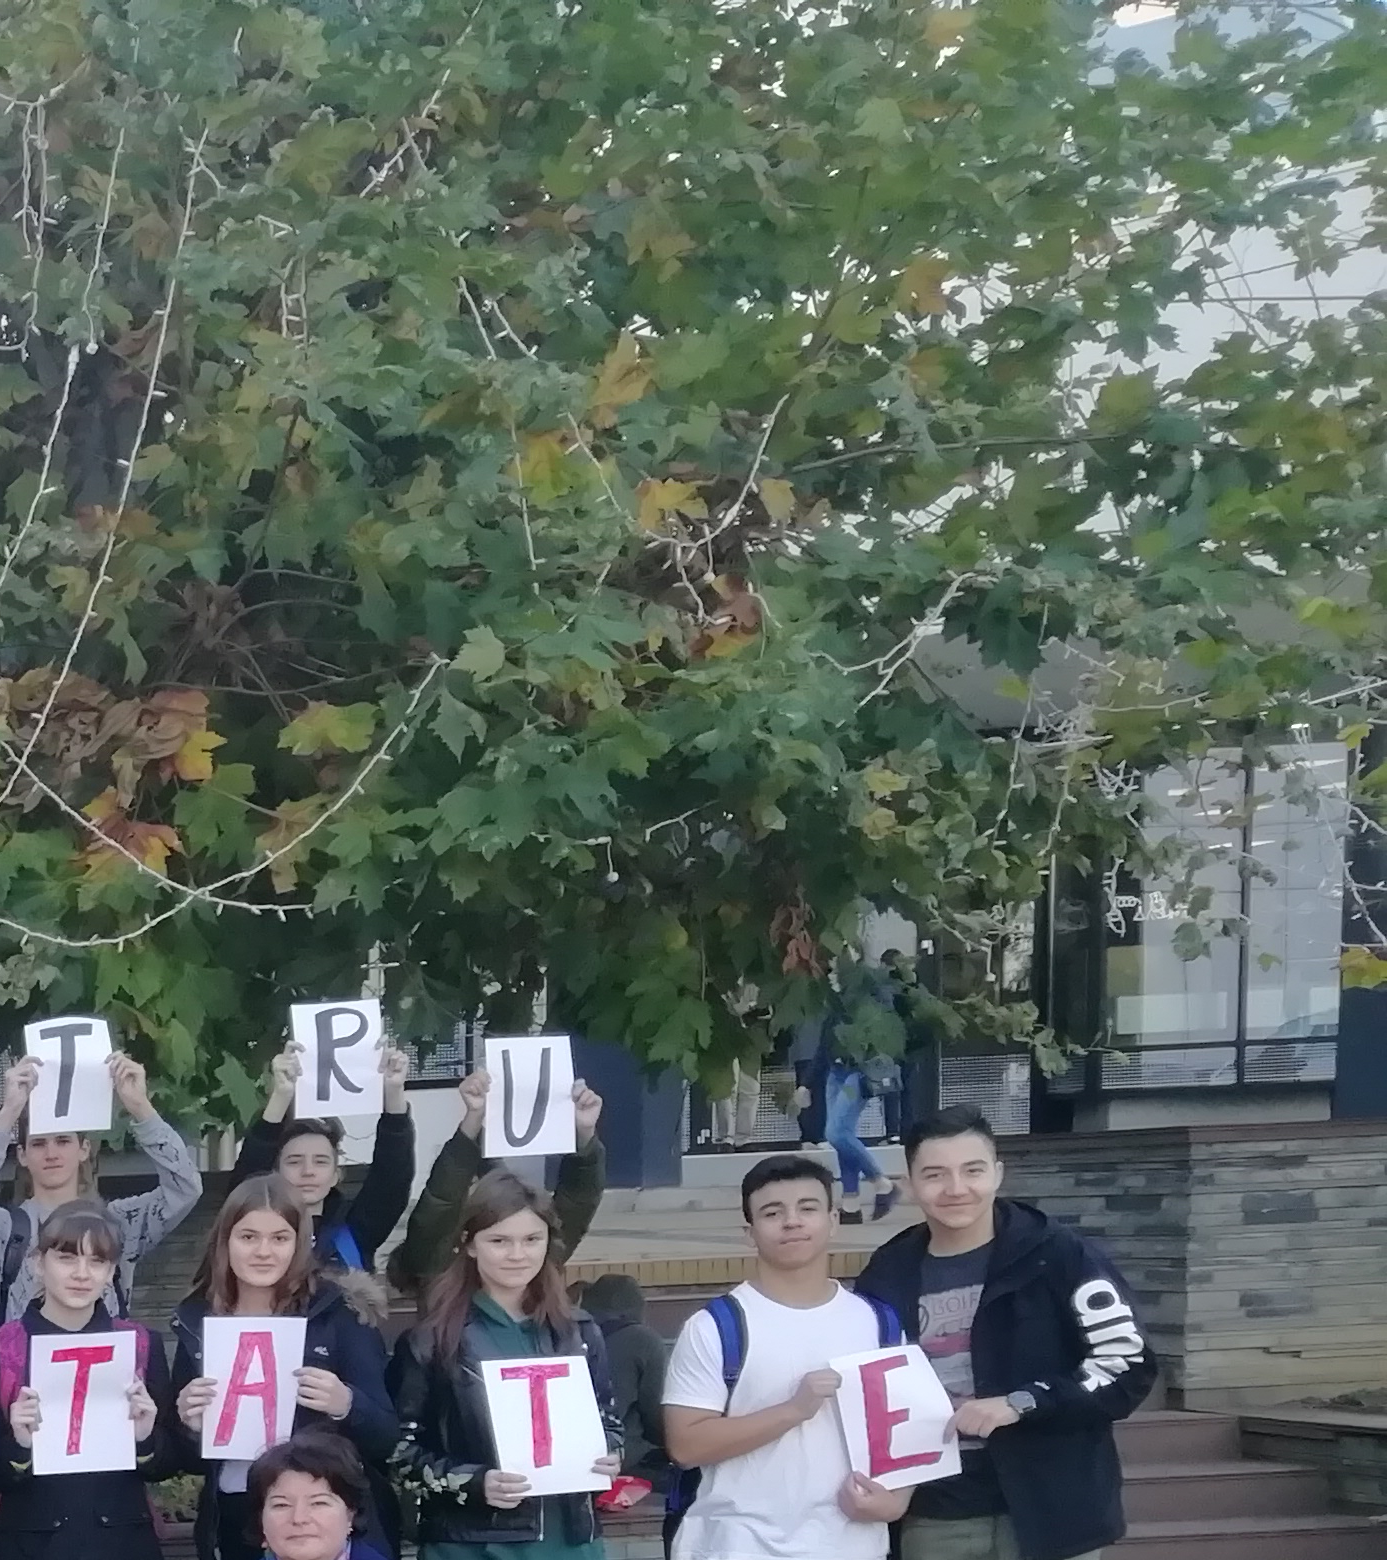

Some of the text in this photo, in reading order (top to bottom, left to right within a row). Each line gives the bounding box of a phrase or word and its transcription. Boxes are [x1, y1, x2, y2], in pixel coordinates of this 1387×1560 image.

[39, 1023, 94, 1118] T
[315, 1007, 369, 1101] R
[501, 1047, 552, 1147] U
[51, 1345, 116, 1456] T
[213, 1331, 278, 1449] A
[500, 1363, 570, 1468] T
[859, 1353, 945, 1480] E
